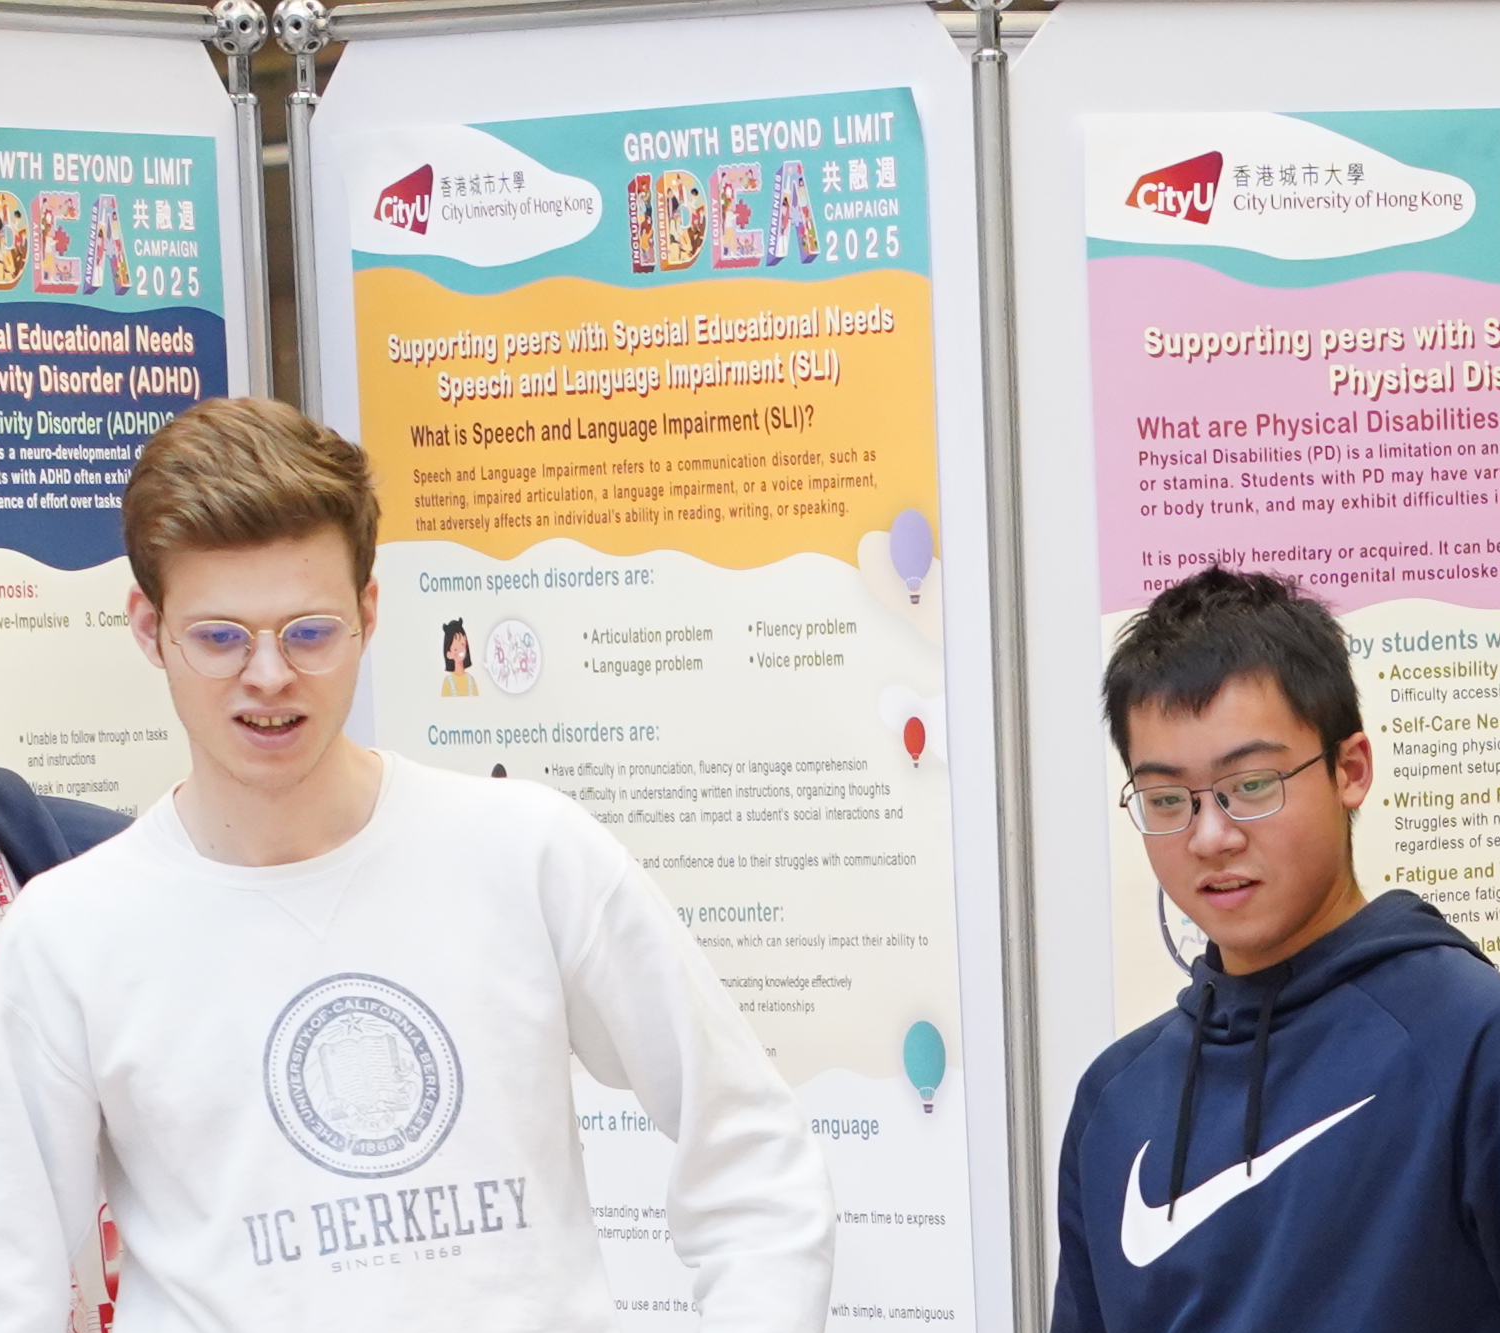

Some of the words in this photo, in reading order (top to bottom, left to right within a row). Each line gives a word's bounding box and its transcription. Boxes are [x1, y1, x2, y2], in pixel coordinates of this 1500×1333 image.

[623, 127, 720, 163] GROWTH
[730, 118, 822, 155] BEYOND
[833, 112, 894, 147] LIMIT
[53, 152, 133, 185] BEYOND
[144, 157, 193, 187] LIMIT
[440, 170, 526, 199] 香港城市大學
[822, 157, 897, 193] 共融週
[1233, 162, 1365, 187] 香港城市大學
[380, 194, 430, 228] CityU
[824, 197, 899, 222] CAMPAIGN
[1138, 181, 1215, 215] CityU
[133, 198, 195, 233] 共融週
[134, 238, 198, 258] CAMPAIGN
[826, 226, 901, 262] 2025
[137, 266, 200, 298] 2025
[39, 365, 123, 396] Disorder
[129, 367, 200, 400] (ADHD)
[438, 370, 514, 405] Speech
[519, 366, 557, 398] and
[563, 361, 661, 399] Language
[665, 356, 784, 393] Impairment
[788, 350, 841, 389] (SLI)
[1329, 363, 1454, 396] Physical
[419, 571, 483, 595] Common
[487, 568, 541, 598] speech
[544, 567, 621, 590] disorders
[624, 567, 655, 587] are:
[591, 626, 663, 646] Articulation
[666, 625, 714, 645] problem
[755, 619, 803, 641] Fluency
[806, 617, 858, 640] problem
[756, 651, 791, 670] Voice
[794, 650, 845, 671] problem
[1390, 663, 1498, 682] Accessibility
[1392, 715, 1472, 734] Self-Care
[1395, 791, 1456, 811] Writing
[1461, 789, 1491, 805] and
[1396, 865, 1458, 885] Fatigue
[1463, 864, 1494, 880] and
[242, 1208, 302, 1267] UC
[311, 1177, 528, 1257] BERKELEY
[330, 1252, 402, 1273] SINCE
[414, 1245, 462, 1261] 1868
